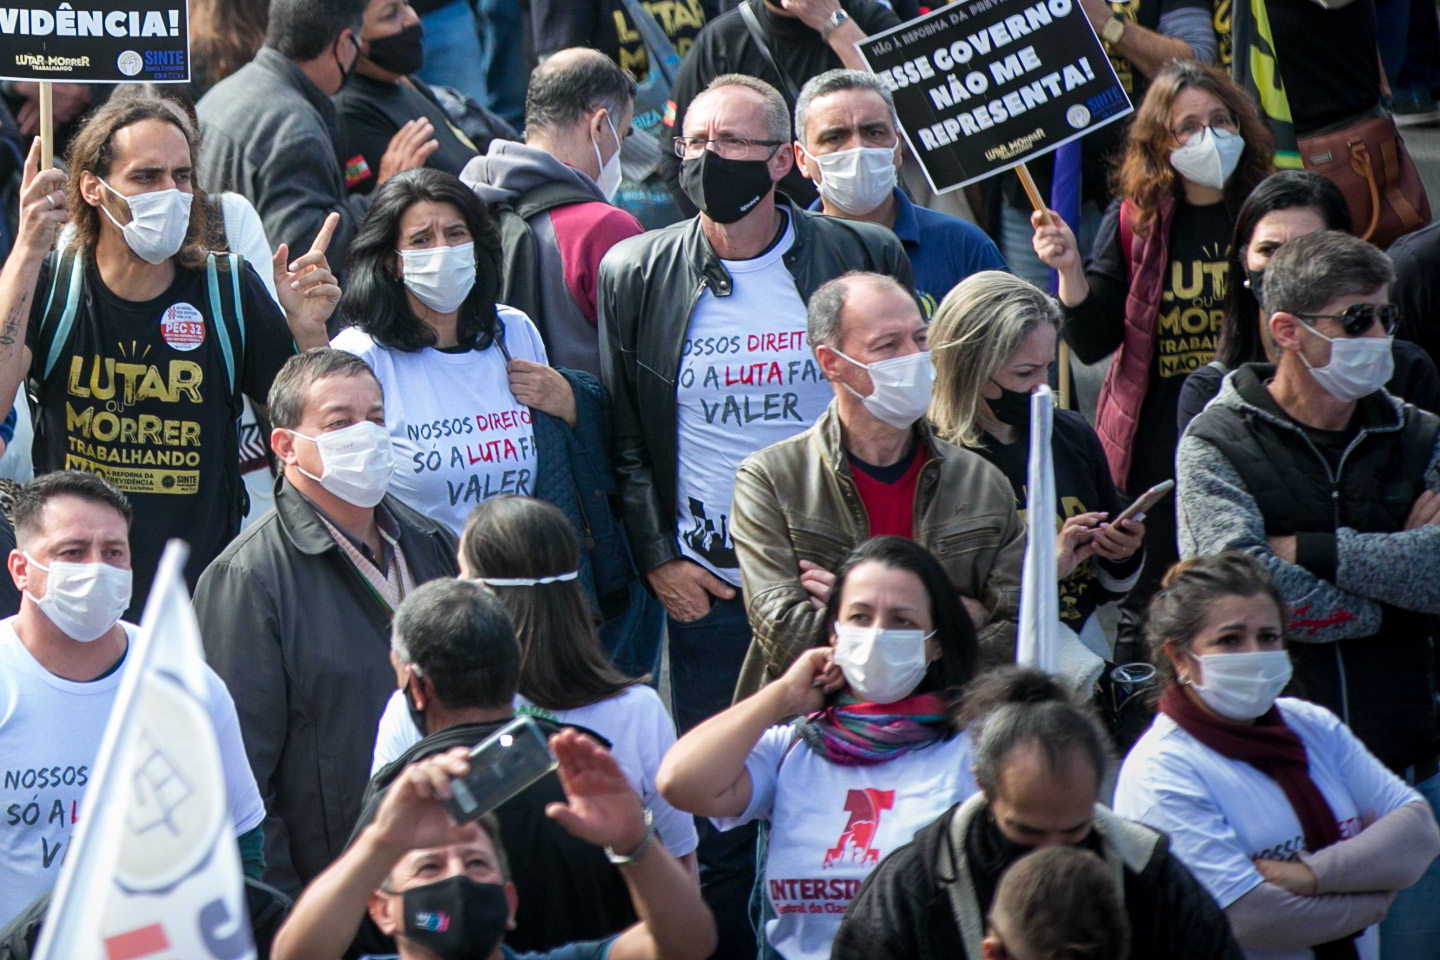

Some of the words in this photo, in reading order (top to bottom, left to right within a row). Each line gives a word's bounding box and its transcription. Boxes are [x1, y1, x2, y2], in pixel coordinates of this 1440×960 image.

[949, 9, 969, 25] DA
[15, 53, 45, 68] LUTAR
[48, 56, 90, 67] MORRER
[144, 50, 184, 66] SINTE
[879, 55, 935, 92] ESSE
[929, 71, 989, 110] NÃO
[989, 45, 1042, 85] ME
[917, 56, 1096, 151] REPRESENTA!
[1192, 296, 1213, 309] OU
[165, 323, 188, 334] PEC
[190, 324, 202, 335] 32
[747, 331, 810, 353] DIREIT
[703, 366, 719, 390] A
[725, 361, 783, 387] LUTA
[1161, 356, 1200, 373] NÃO
[67, 354, 203, 406] LUTAR
[106, 400, 124, 413] OU
[700, 392, 804, 427] VALER
[66, 401, 201, 446] MORRER
[407, 417, 473, 441] NOSSOS
[67, 435, 200, 466] TRABALHANDO
[412, 443, 442, 474] SÓ
[450, 446, 465, 470] A
[466, 438, 519, 465] LUTA
[106, 477, 154, 486] PREVIDÊNCIA
[112, 471, 143, 479] REFORMA
[176, 475, 197, 484] SINTE
[447, 468, 531, 506] VALER
[4, 765, 88, 790] NOSSOS
[6, 794, 40, 826] SÓ
[48, 799, 64, 828] A
[808, 902, 823, 914] da
